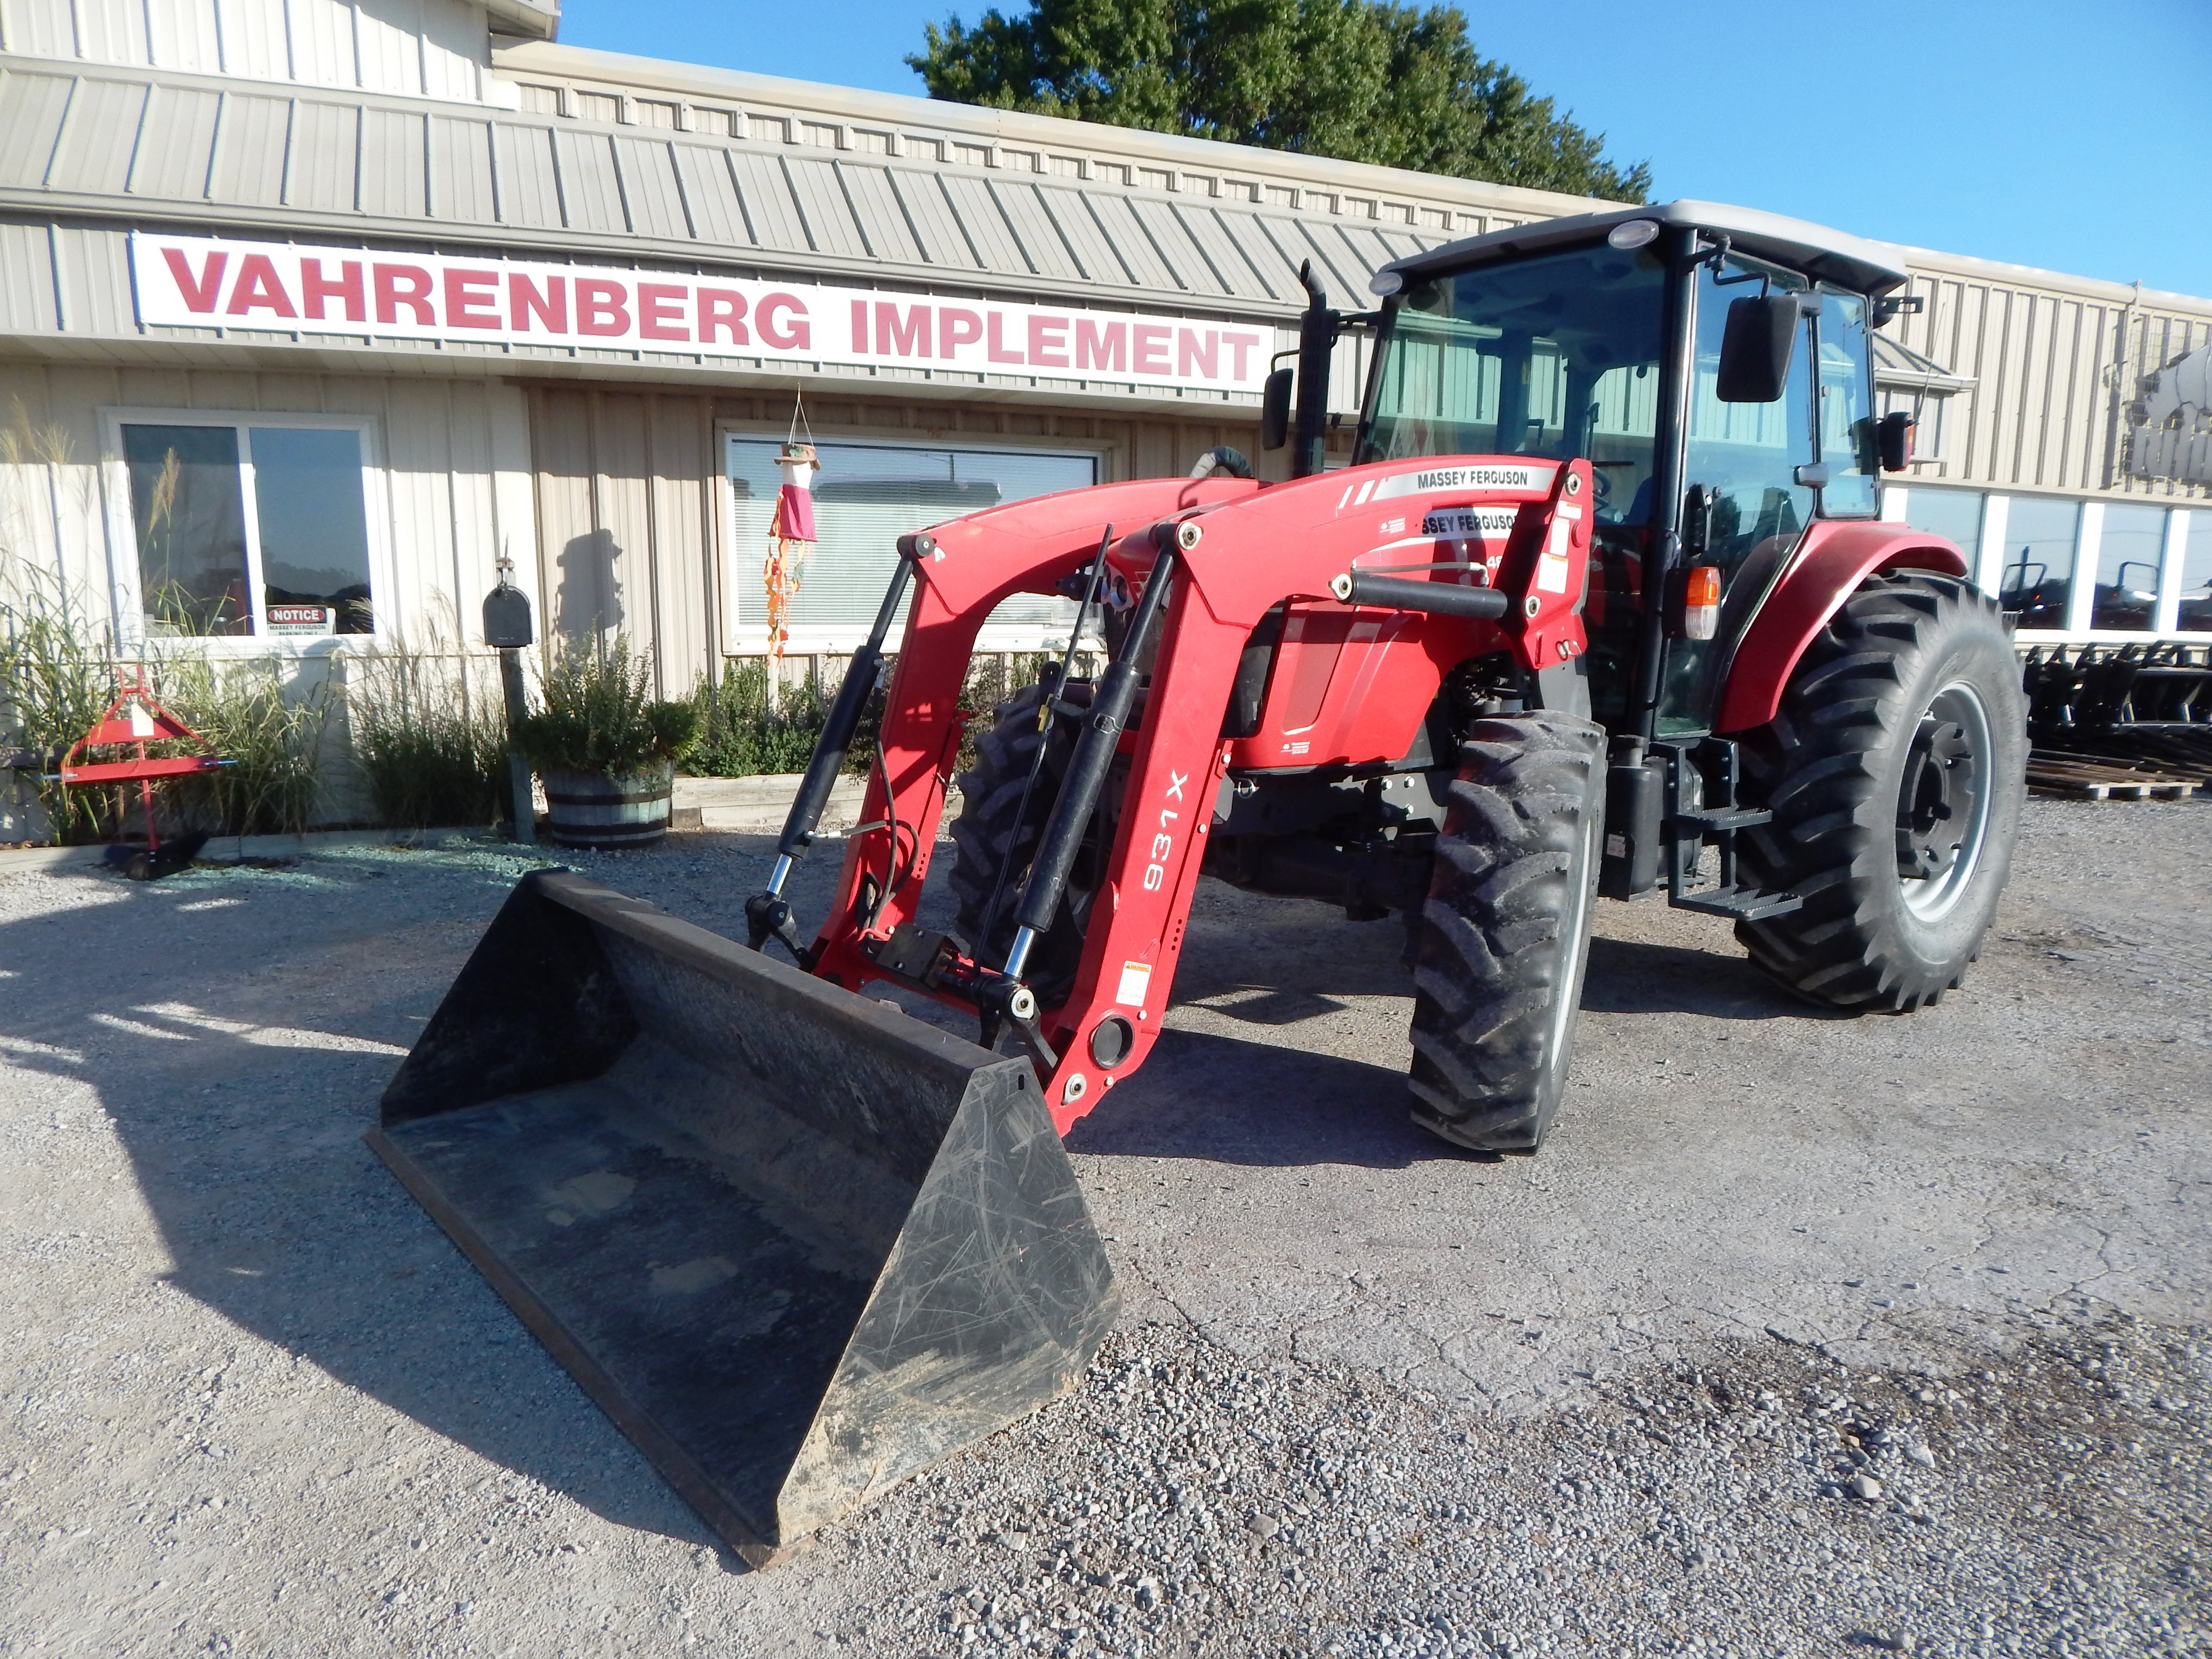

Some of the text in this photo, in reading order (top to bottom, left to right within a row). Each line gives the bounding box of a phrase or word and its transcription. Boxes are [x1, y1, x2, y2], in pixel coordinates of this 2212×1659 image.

[161, 248, 1260, 382] VAHRENBERG IMPLEMENT
[1418, 470, 1527, 489] MASSEY FERGUSON
[1457, 515, 1517, 531] FERGUSO
[273, 610, 320, 621] NOTICE
[1143, 769, 1189, 891] 931 X
[1130, 964, 1150, 973] WARNING
